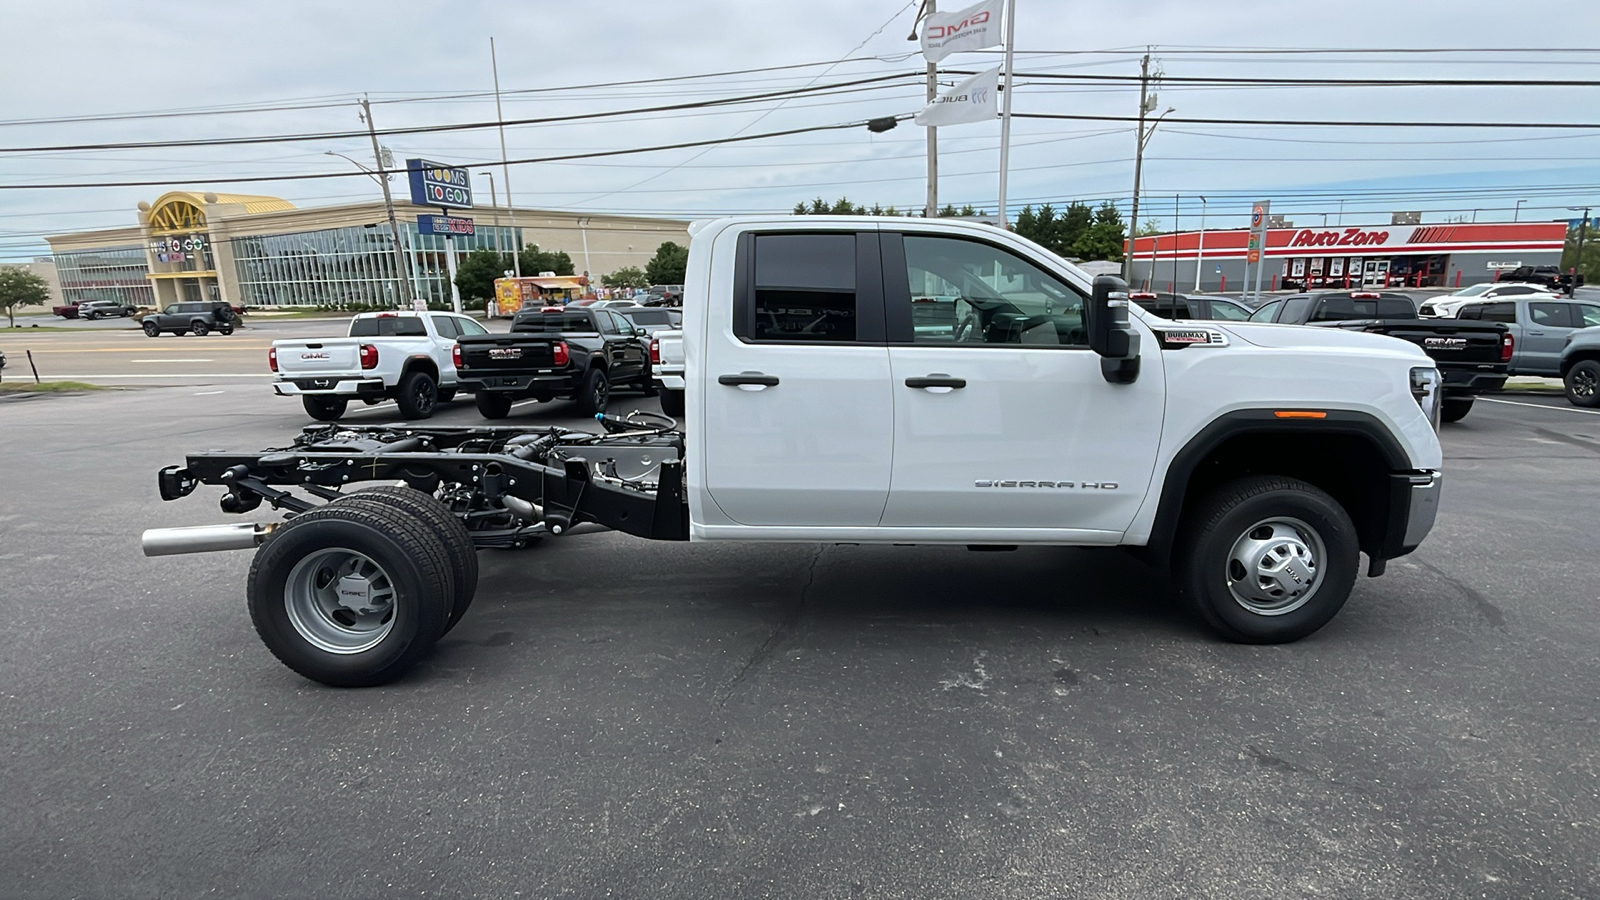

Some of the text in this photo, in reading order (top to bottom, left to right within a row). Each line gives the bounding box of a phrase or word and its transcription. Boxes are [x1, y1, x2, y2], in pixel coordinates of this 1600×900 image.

[427, 165, 466, 186] ROOMS
[429, 185, 463, 203] TO GO
[449, 218, 474, 234] KIDS
[184, 238, 203, 251] GO
[1425, 337, 1467, 346] GMC
[300, 352, 330, 360] GMC
[488, 348, 521, 356] GMC
[974, 479, 1119, 490] SIERRA HD
[341, 589, 367, 597] GMC
